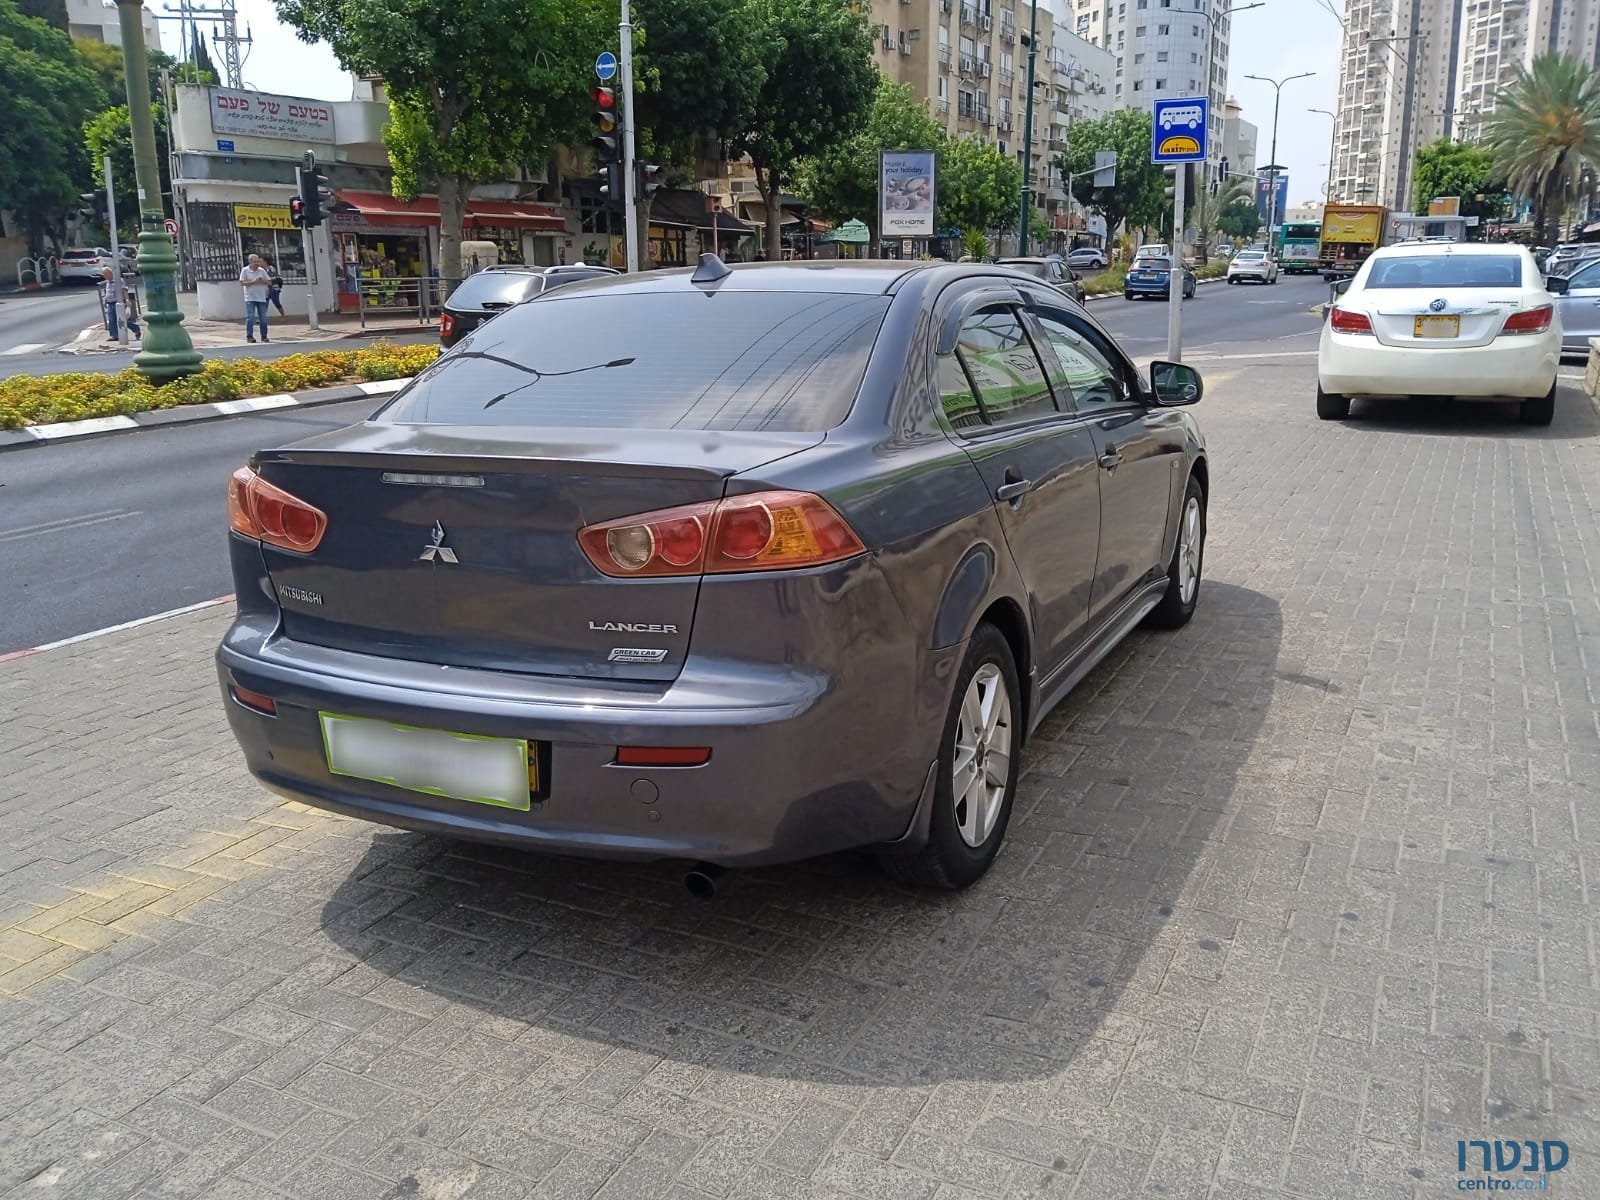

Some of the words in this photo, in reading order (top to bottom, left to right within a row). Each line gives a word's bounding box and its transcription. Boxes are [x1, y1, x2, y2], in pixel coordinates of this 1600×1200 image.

[217, 95, 249, 112] פעם
[256, 97, 280, 115] של
[288, 104, 329, 121] בטעם
[900, 167, 923, 175] holiday
[247, 214, 291, 227] נדלריה
[279, 585, 322, 605] MITSUBISHI
[588, 620, 678, 634] LANCER
